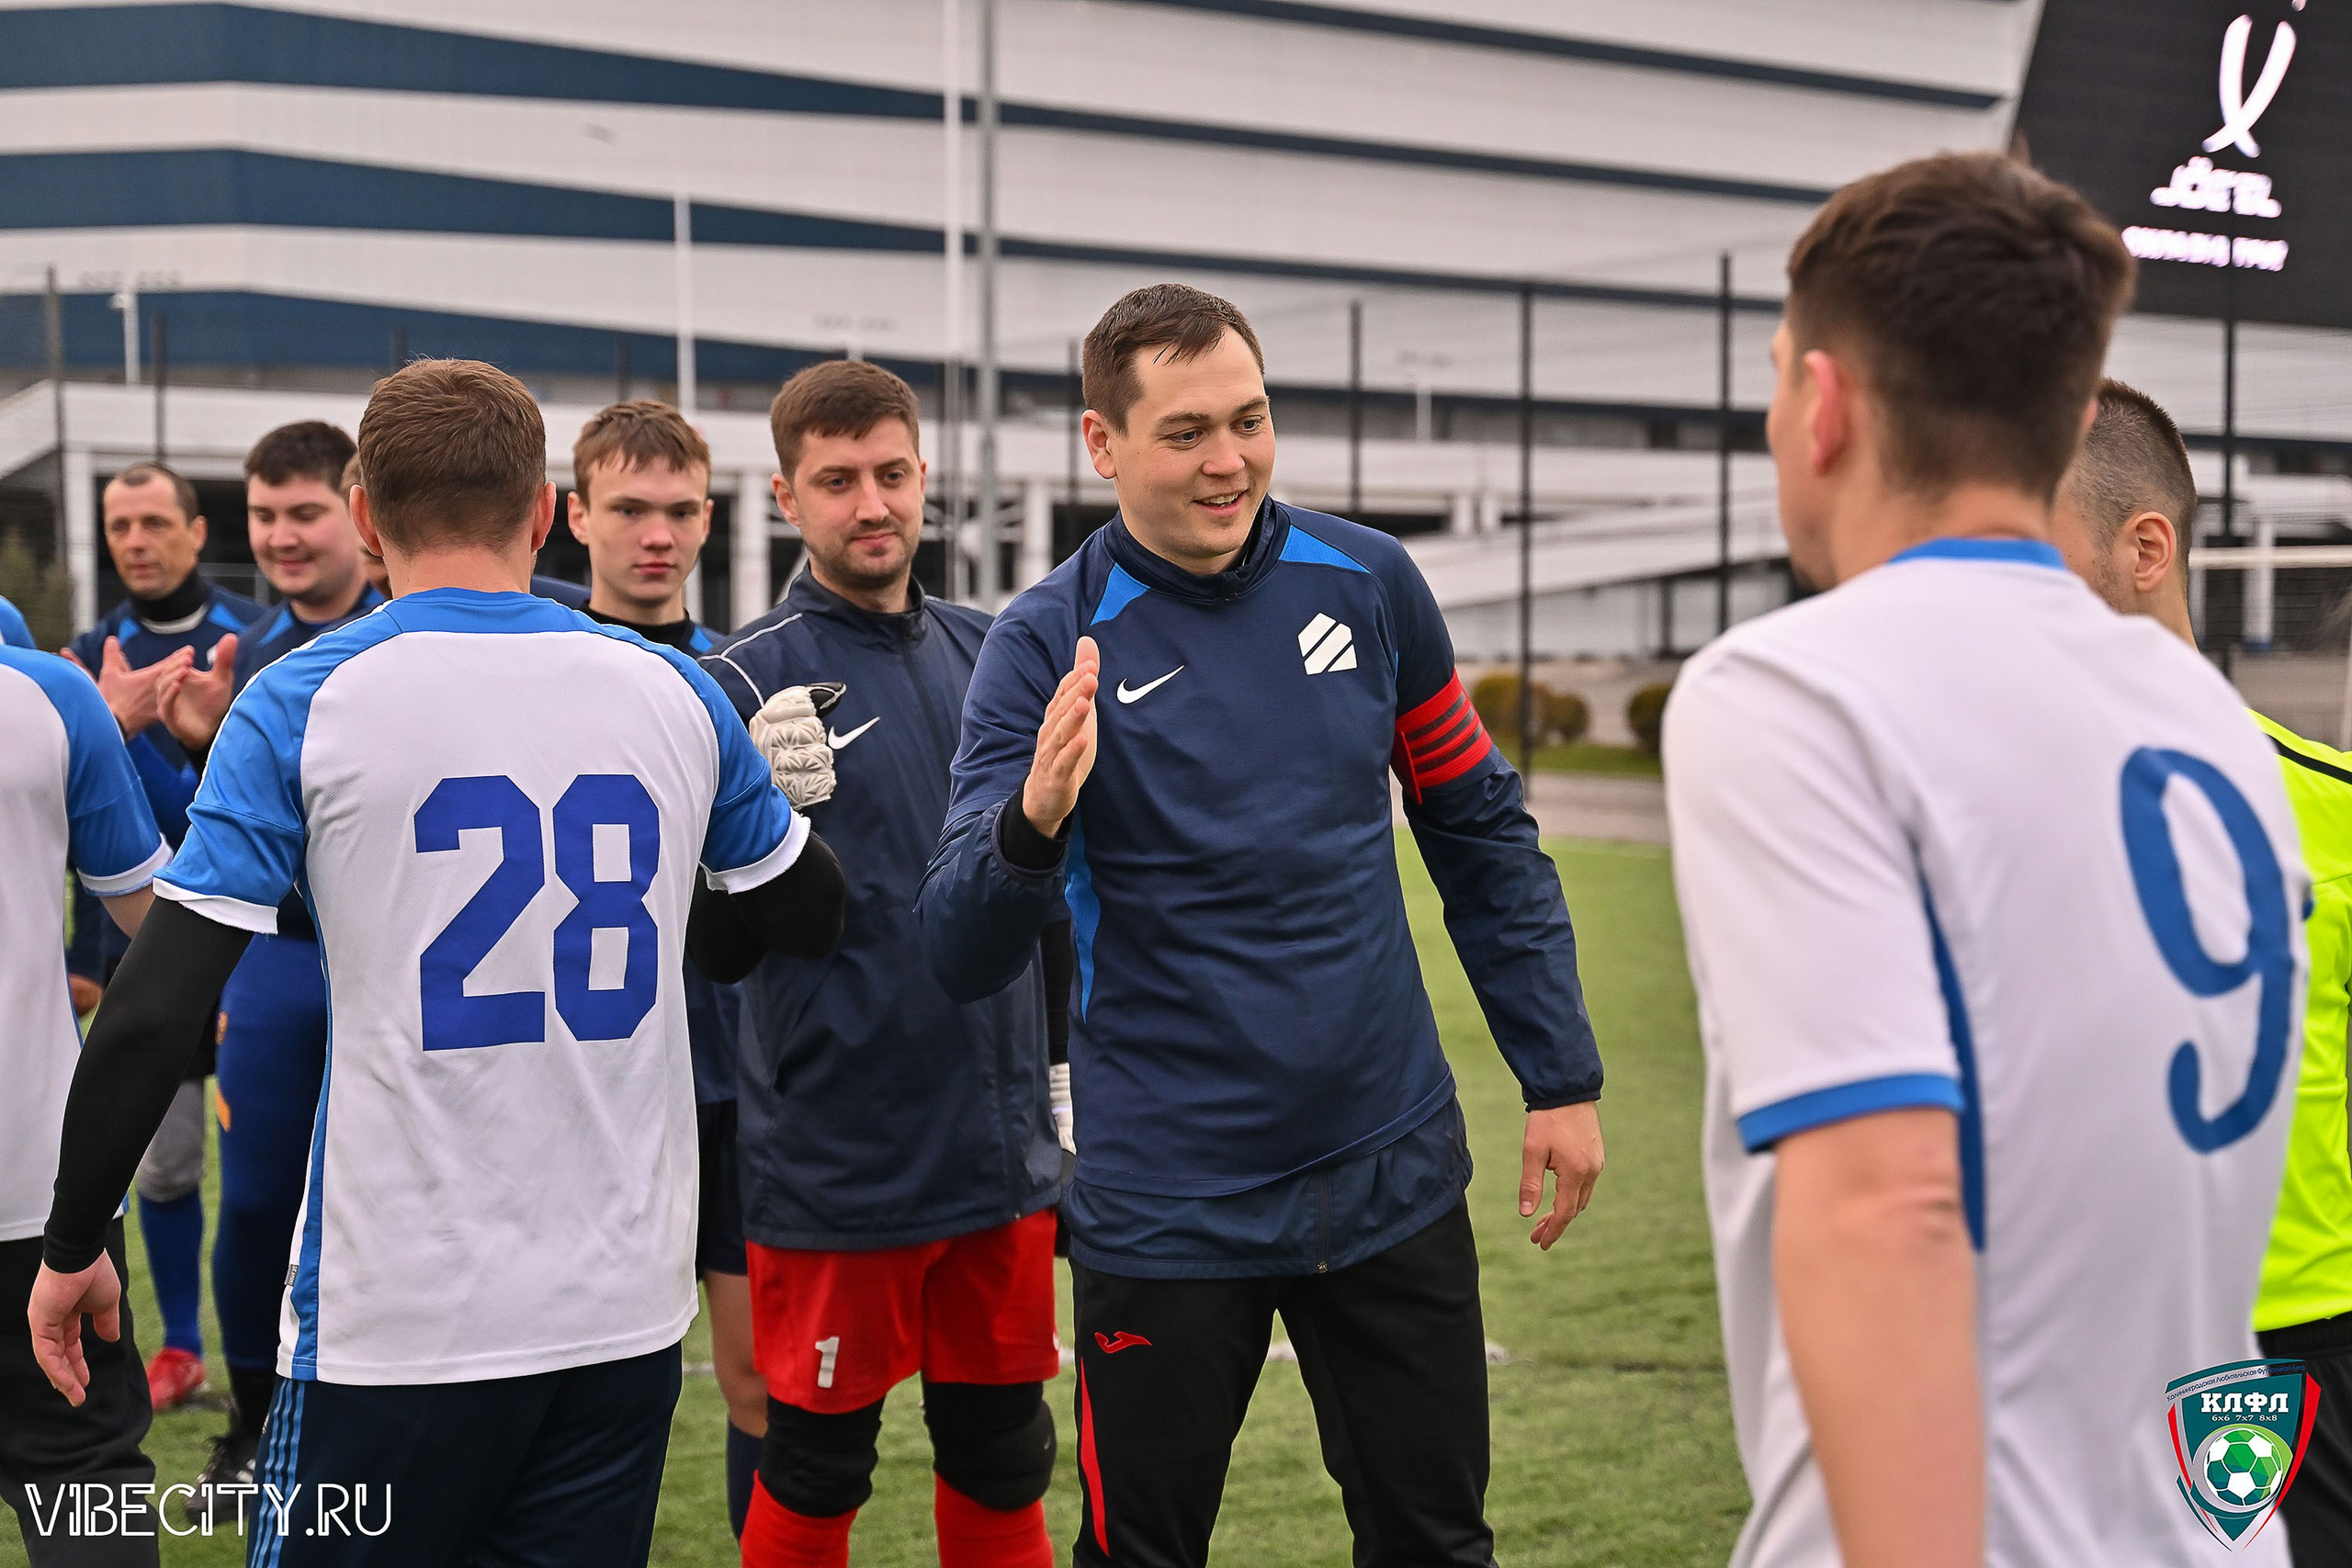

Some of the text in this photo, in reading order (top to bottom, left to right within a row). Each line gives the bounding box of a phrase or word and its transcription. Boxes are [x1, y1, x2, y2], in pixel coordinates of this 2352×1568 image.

[413, 773, 660, 1051] 28
[2120, 746, 2294, 1155] 9
[815, 1337, 840, 1388] 1
